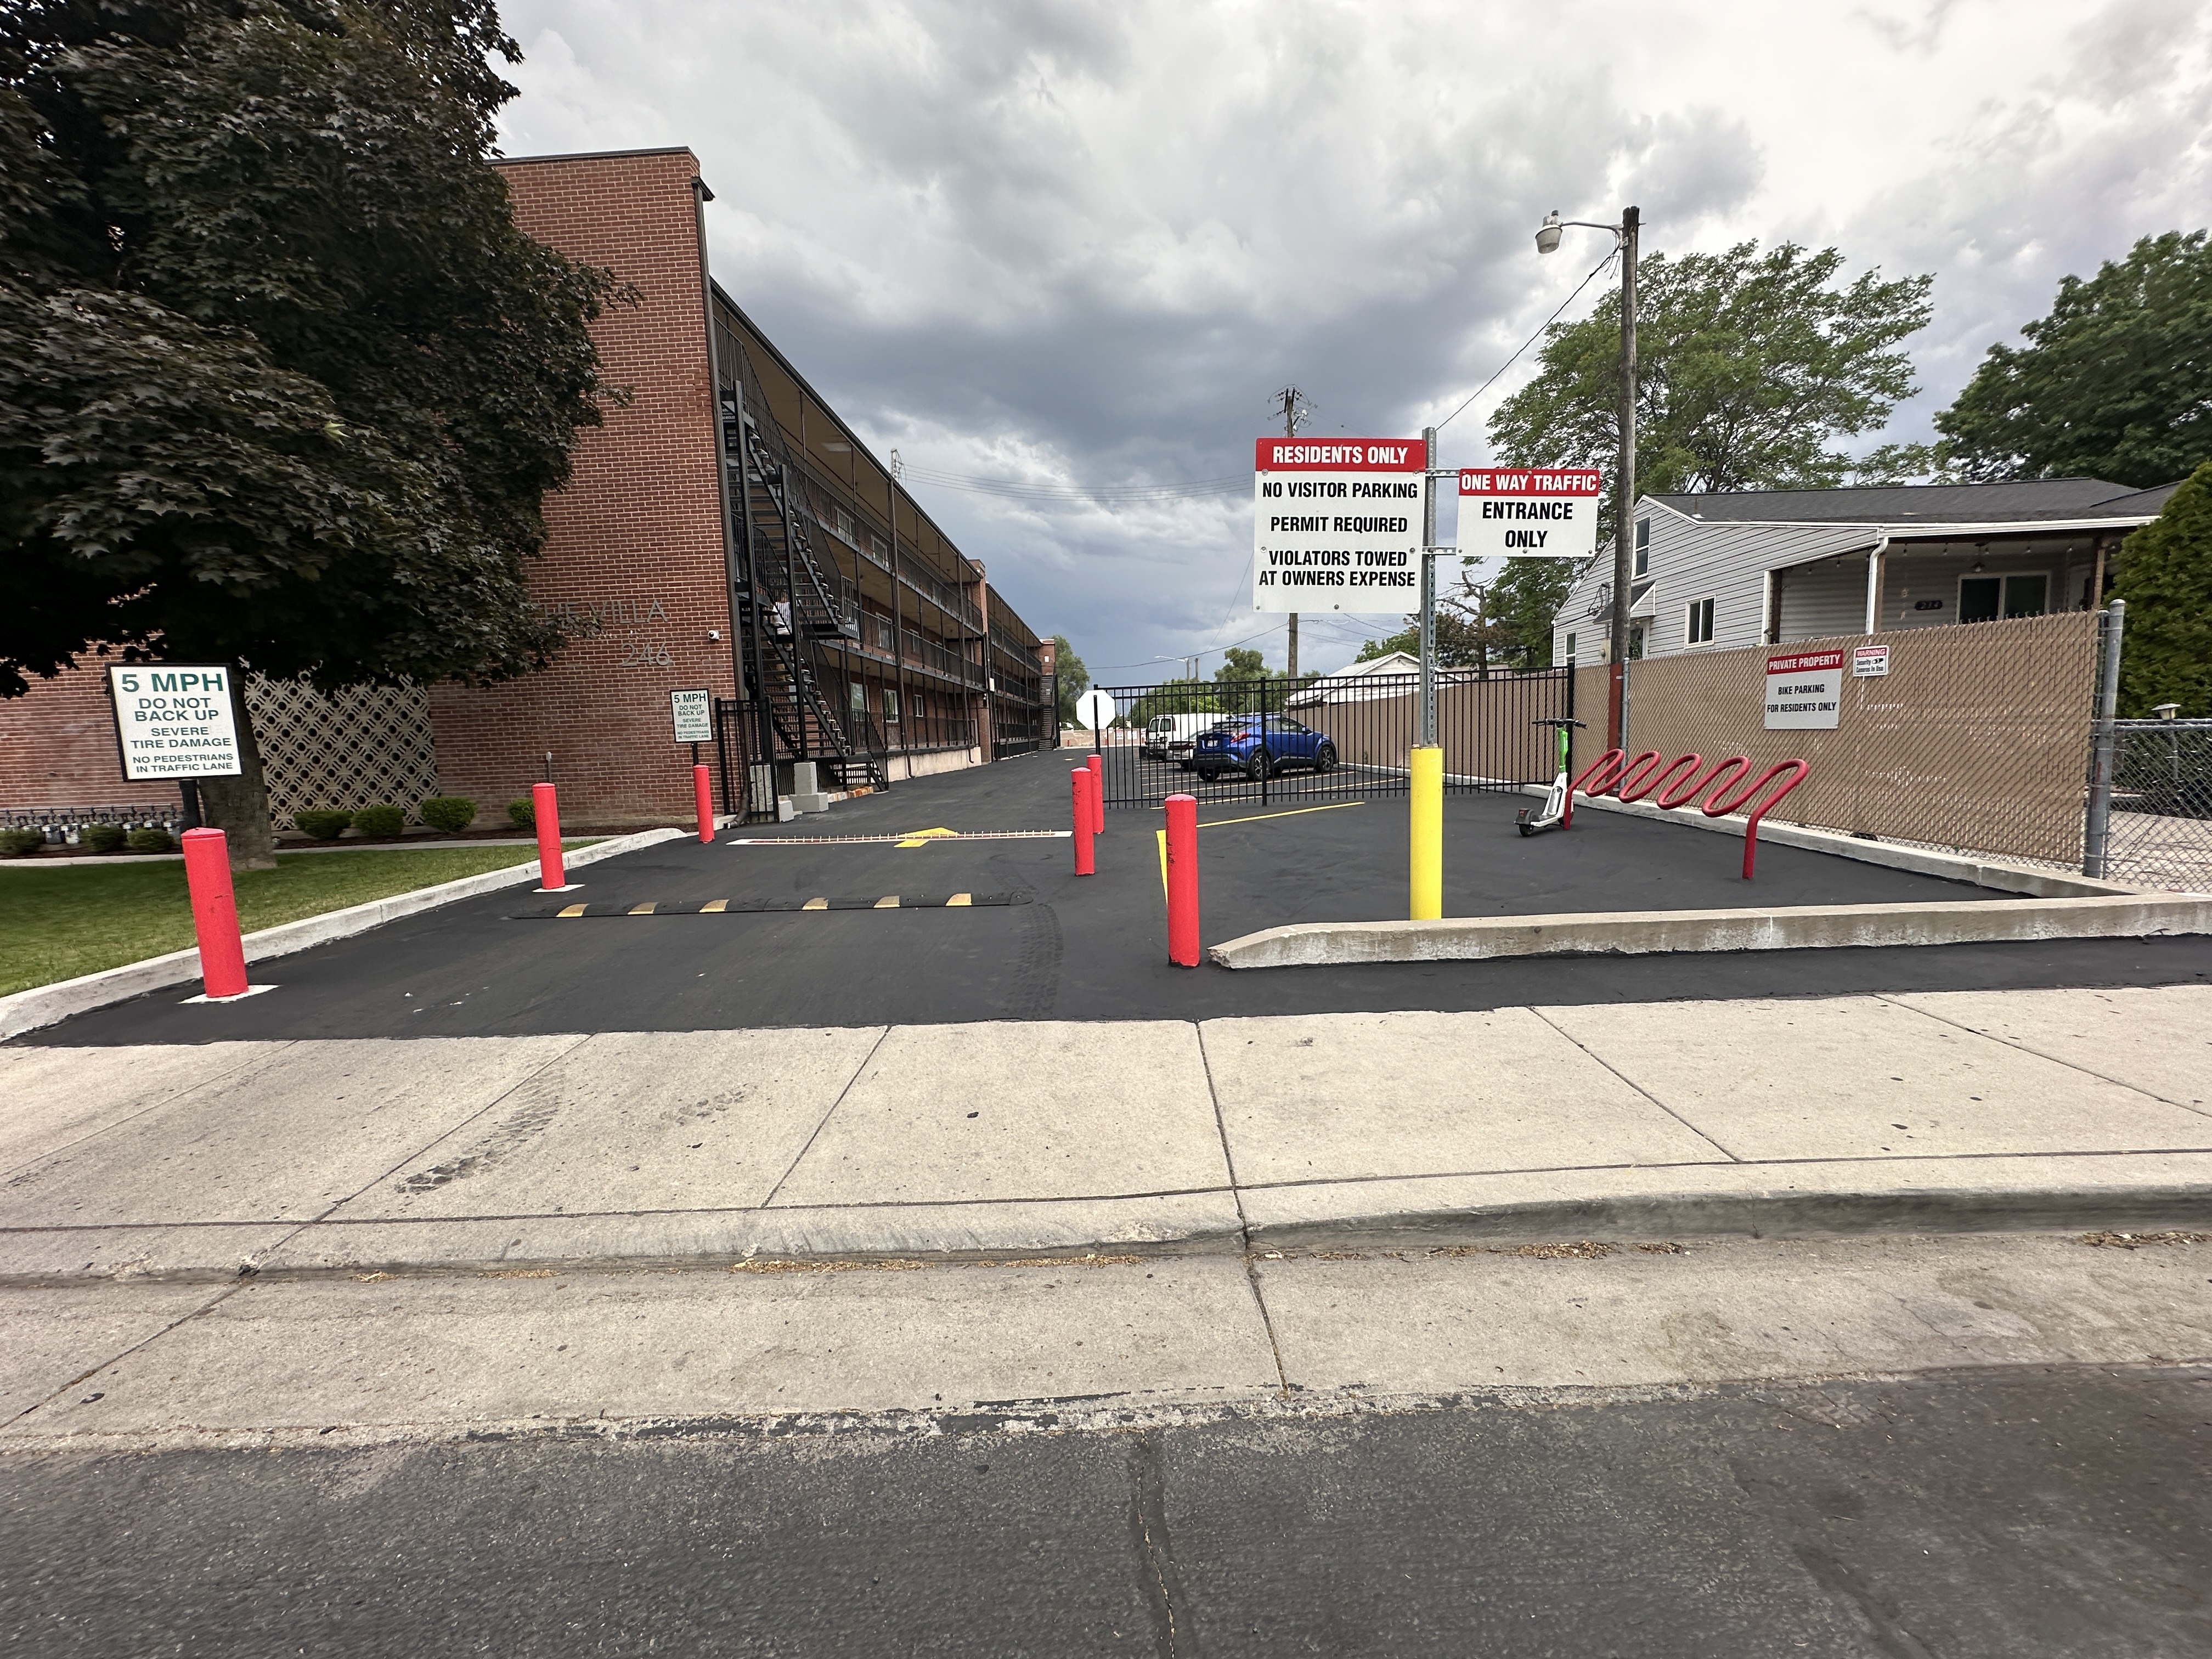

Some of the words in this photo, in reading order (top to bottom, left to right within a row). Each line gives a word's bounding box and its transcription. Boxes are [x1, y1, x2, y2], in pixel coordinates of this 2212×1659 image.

[1273, 445, 1363, 464] RESIDENTS
[1368, 447, 1408, 464] ONLY
[1262, 482, 1282, 498] NO
[1288, 482, 1347, 498] VISITOR
[1352, 483, 1418, 498] PARKING
[1462, 474, 1491, 490] ONE
[1496, 474, 1529, 491] WAY
[1534, 475, 1596, 491] TRAFFIC
[1482, 501, 1573, 520] ENTRANCE
[1271, 517, 1329, 532] PERMIT
[1334, 517, 1408, 534] REQUIRED
[1505, 530, 1548, 548] ONLY
[1269, 550, 1350, 566] VIOLATORS
[1355, 551, 1407, 566] TOWED
[1259, 571, 1277, 586] AT
[1282, 571, 1344, 586] OWNERS
[1350, 571, 1415, 586] EXPENSE
[620, 642, 670, 667] 246
[1857, 648, 1886, 657] WARNING
[1769, 658, 1797, 671] PRIVATE
[1798, 654, 1841, 668] PROPERTY
[122, 674, 139, 692] 5
[151, 673, 223, 692] MPH
[1778, 686, 1792, 695] BIKE
[1795, 684, 1825, 694] PARKING
[139, 698, 167, 709] DO
[173, 697, 211, 708] NOT
[674, 695, 680, 703] 5
[682, 693, 706, 703] MPH
[1767, 704, 1779, 713] FOR
[1780, 702, 1816, 712] RESIDENTS
[1818, 702, 1836, 711] ONLY
[134, 710, 189, 721] BACK
[195, 710, 219, 720] UP
[151, 727, 210, 736] SEVERE
[131, 740, 165, 749] TIRE
[169, 738, 232, 748] DAMAGE
[154, 753, 234, 763] PEDESTRIANS
[151, 764, 200, 772] TRAFFIC
